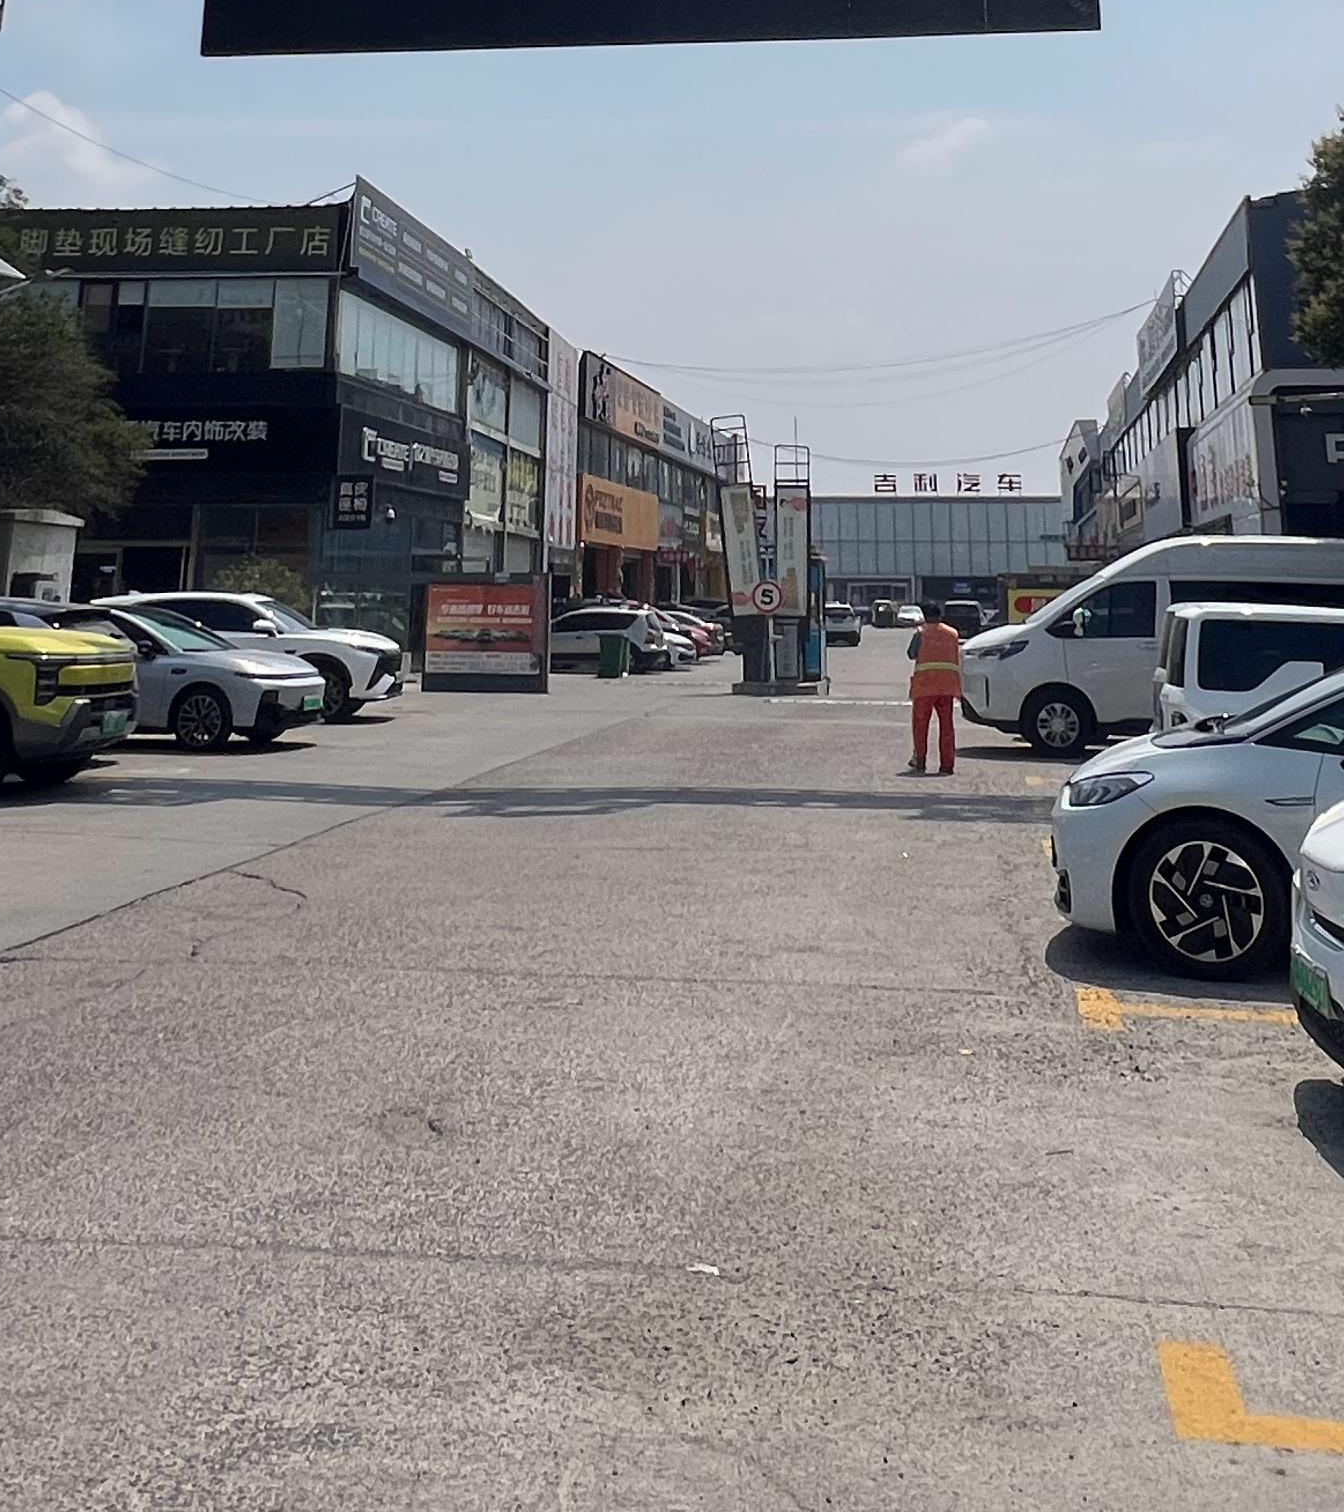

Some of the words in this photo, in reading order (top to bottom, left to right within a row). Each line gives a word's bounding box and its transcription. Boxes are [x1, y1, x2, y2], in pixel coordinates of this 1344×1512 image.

[17, 226, 332, 258] 脚垫现场缝纫工厂店
[122, 420, 268, 441] 汽车内饰改装
[873, 472, 1022, 492] 吉利汽车
[760, 588, 774, 606] 5
